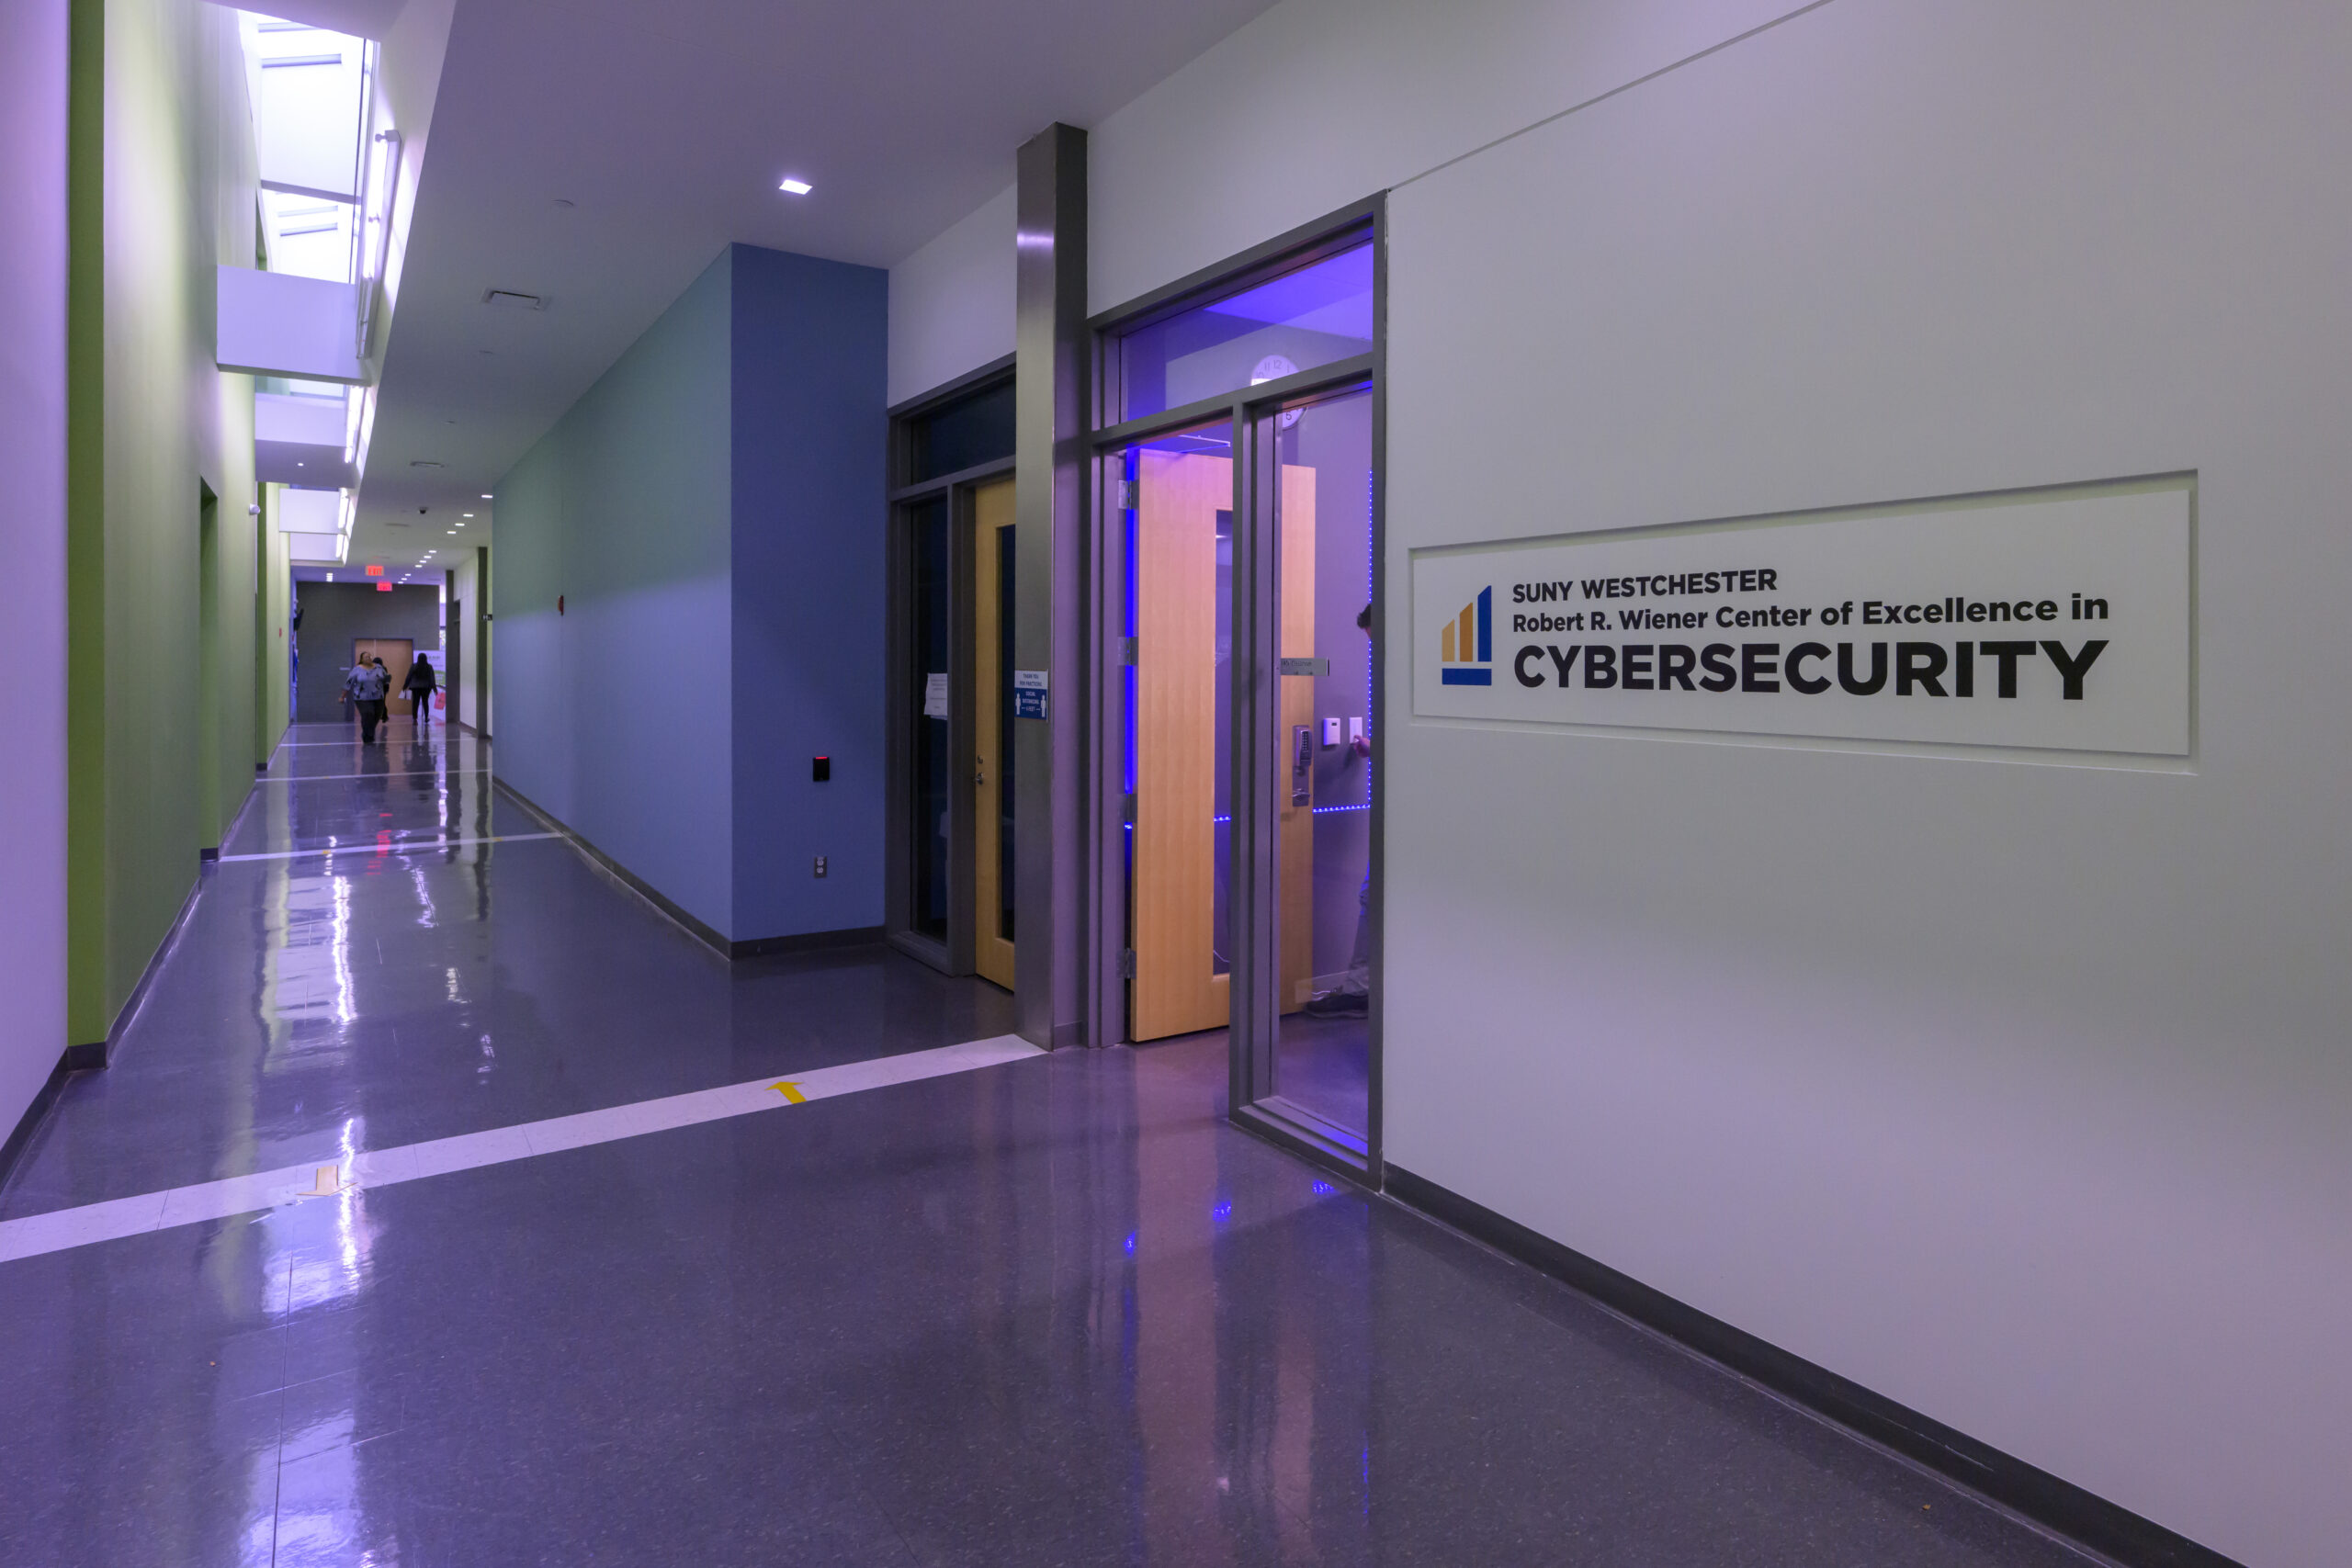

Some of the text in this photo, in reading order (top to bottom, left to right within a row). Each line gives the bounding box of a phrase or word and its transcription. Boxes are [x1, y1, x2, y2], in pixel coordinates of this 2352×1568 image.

[1273, 360, 1283, 369] 12
[368, 565, 383, 576] EXIT
[1512, 570, 1779, 604] SUNY WESTCHESTER
[1513, 592, 2109, 633] Robert R. Wiener Center of Excellence in
[1512, 639, 2110, 701] CYBERSECURITY
